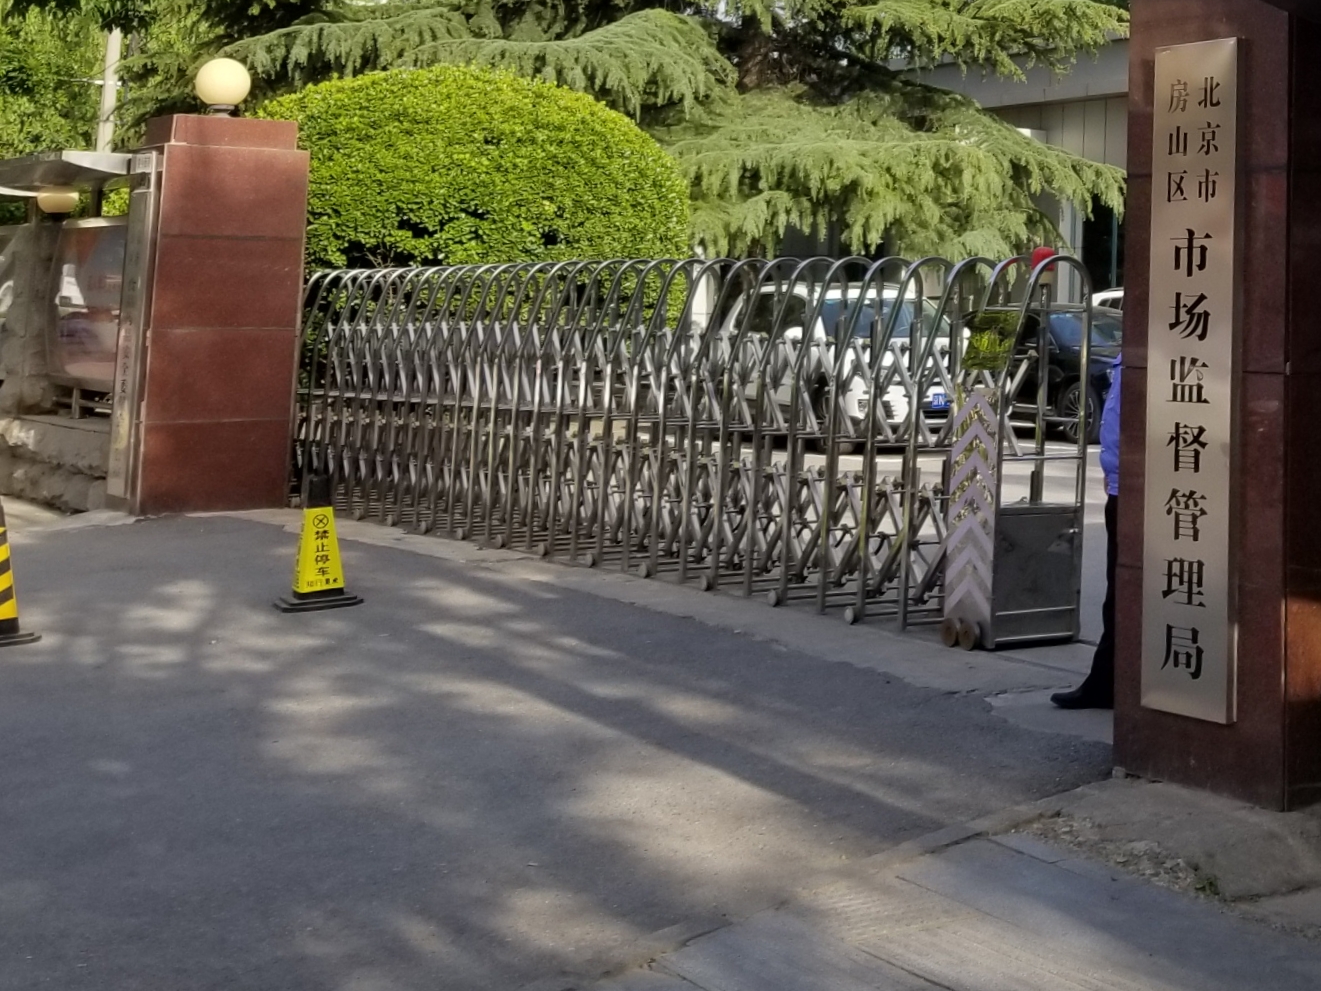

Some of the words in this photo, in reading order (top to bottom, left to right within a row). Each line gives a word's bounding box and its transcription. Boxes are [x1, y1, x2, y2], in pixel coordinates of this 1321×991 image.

[1167, 79, 1190, 203] 房山区
[1197, 76, 1221, 203] 北京市
[1160, 228, 1213, 680] 市场监督管理局
[314, 530, 331, 577] 禁止停车
